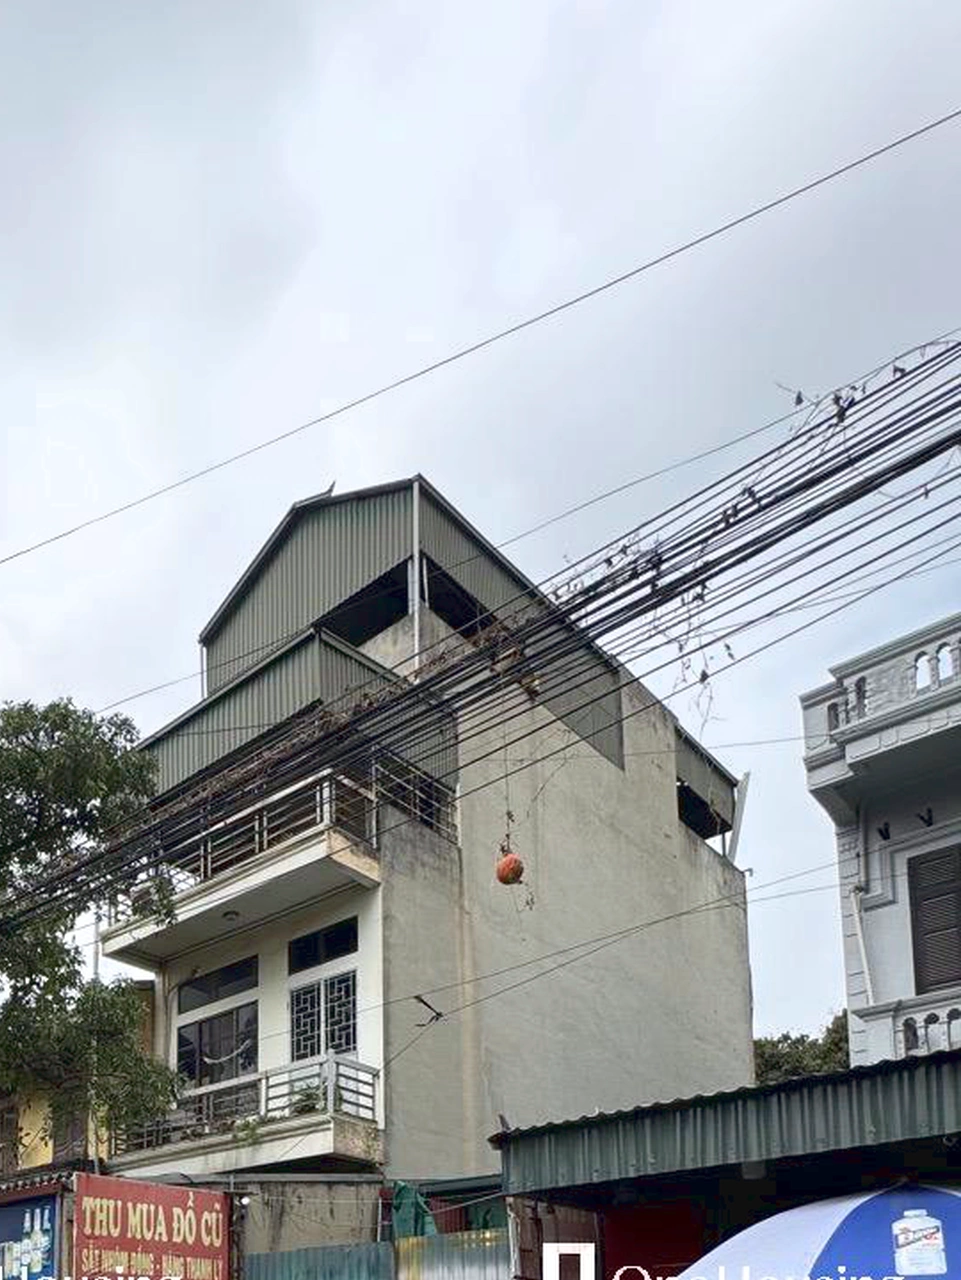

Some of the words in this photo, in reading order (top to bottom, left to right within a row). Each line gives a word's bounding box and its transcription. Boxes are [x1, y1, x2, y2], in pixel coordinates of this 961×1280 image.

[81, 1196, 122, 1238] THU
[126, 1201, 169, 1243] MUA
[200, 1202, 223, 1248] CŨ
